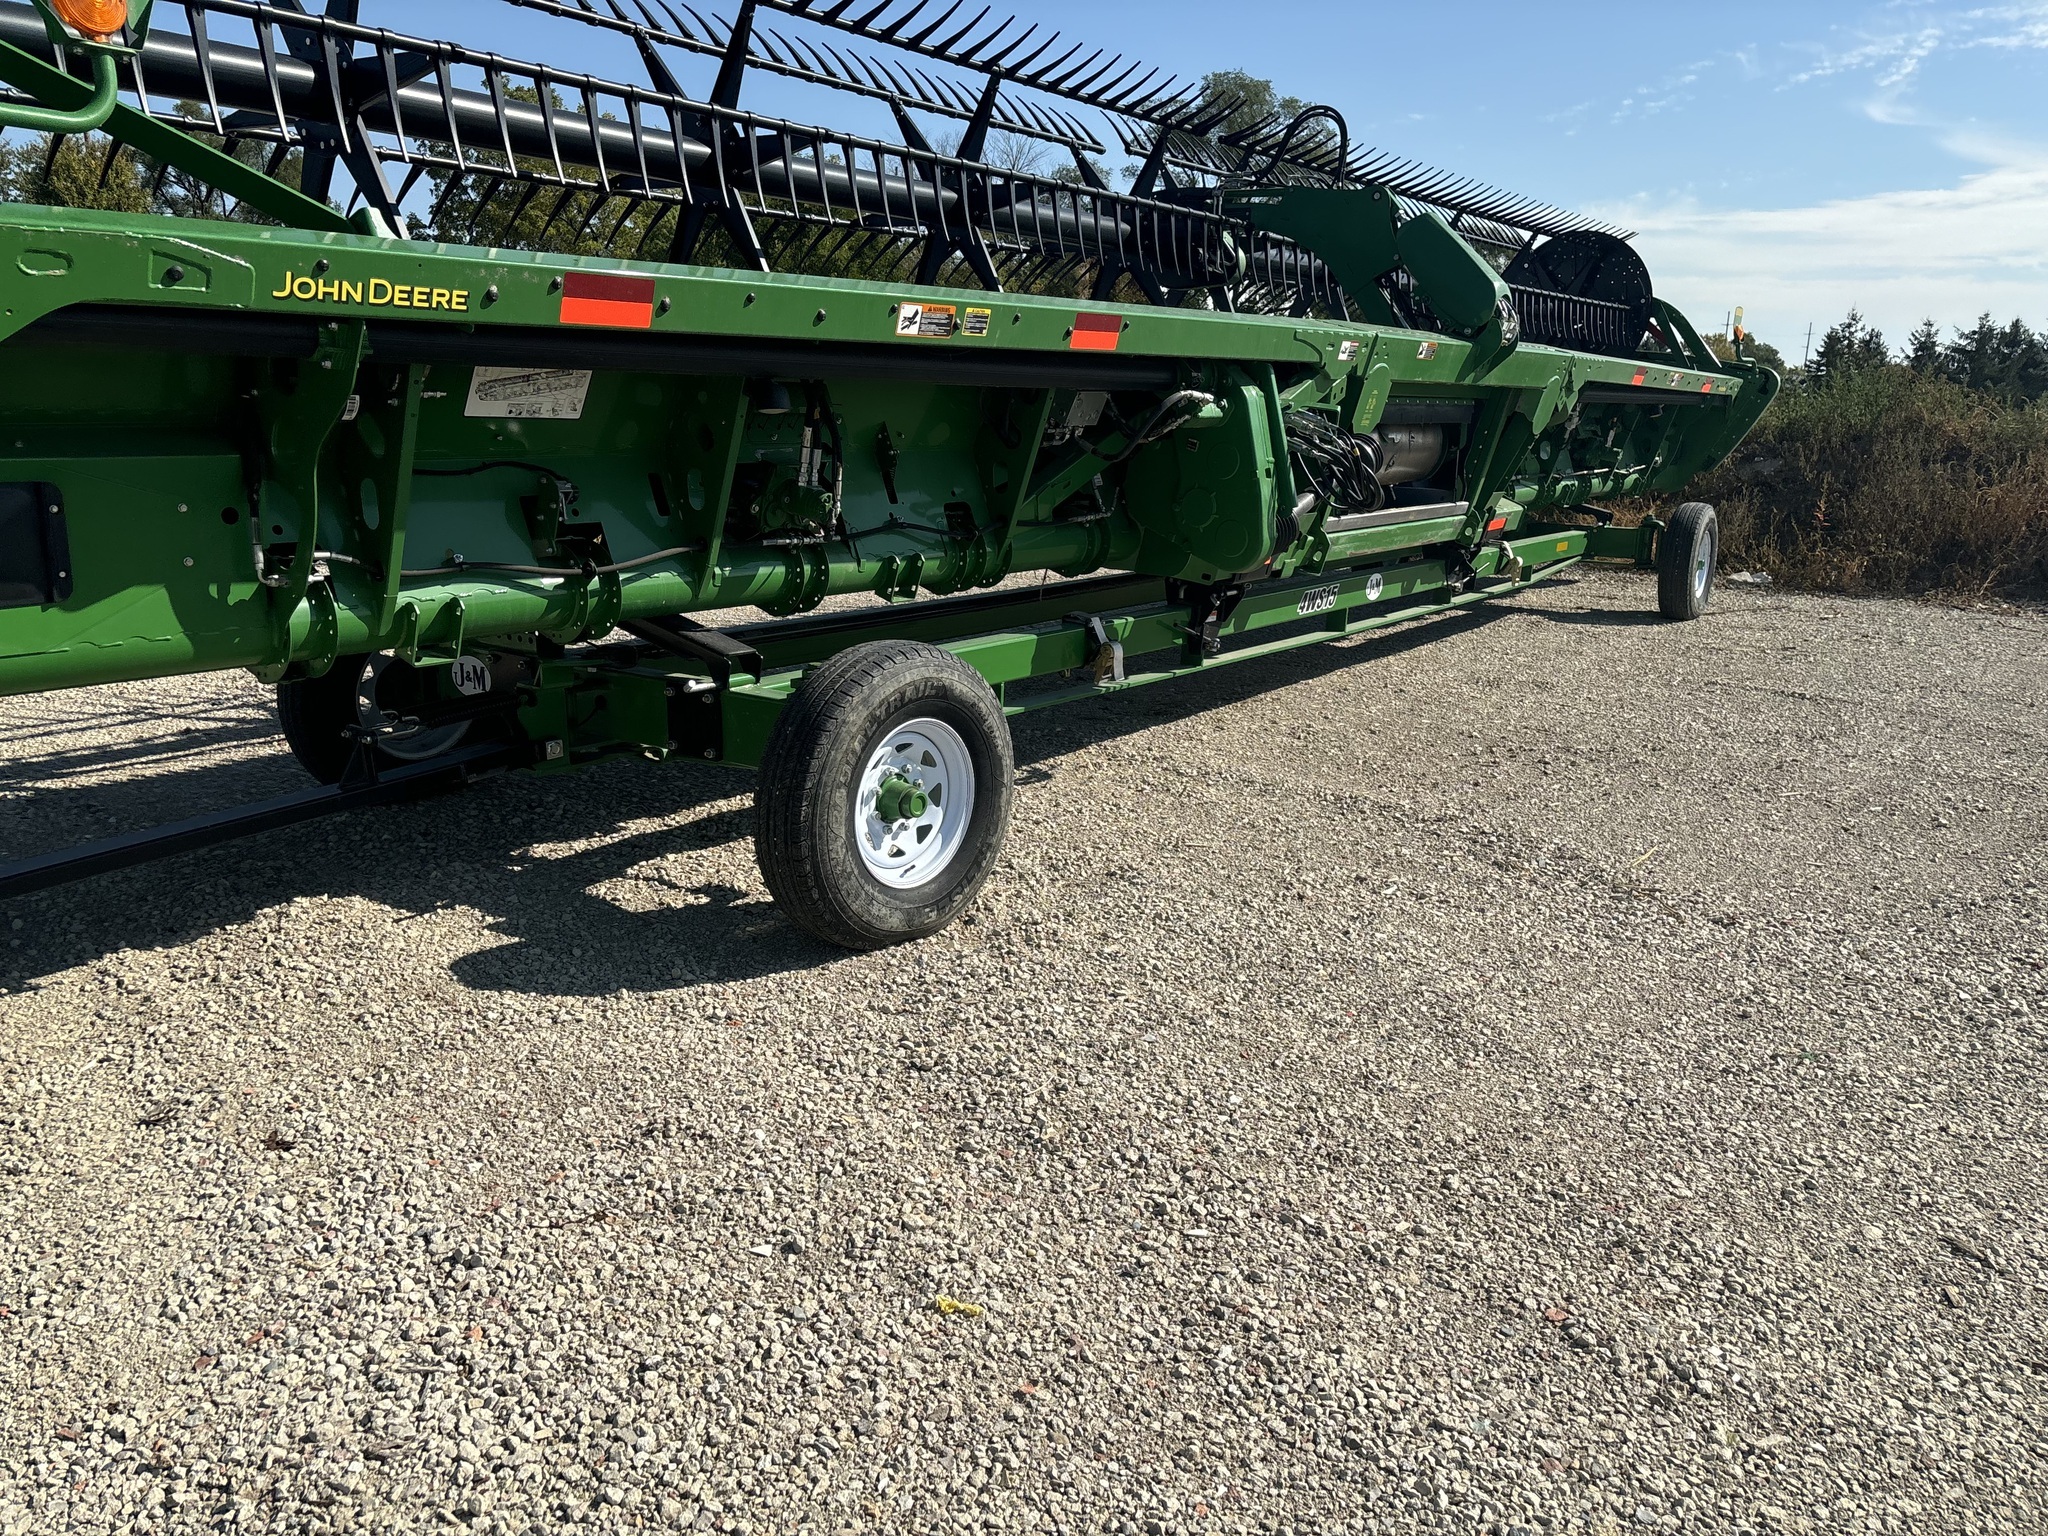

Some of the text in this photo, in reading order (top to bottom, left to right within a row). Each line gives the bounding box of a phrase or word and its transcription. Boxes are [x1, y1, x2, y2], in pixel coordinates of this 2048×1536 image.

[272, 271, 470, 312] JOHN DEERE
[1297, 584, 1340, 615] 4WS15
[453, 662, 487, 692] J&M
[876, 681, 937, 721] TRAIL
